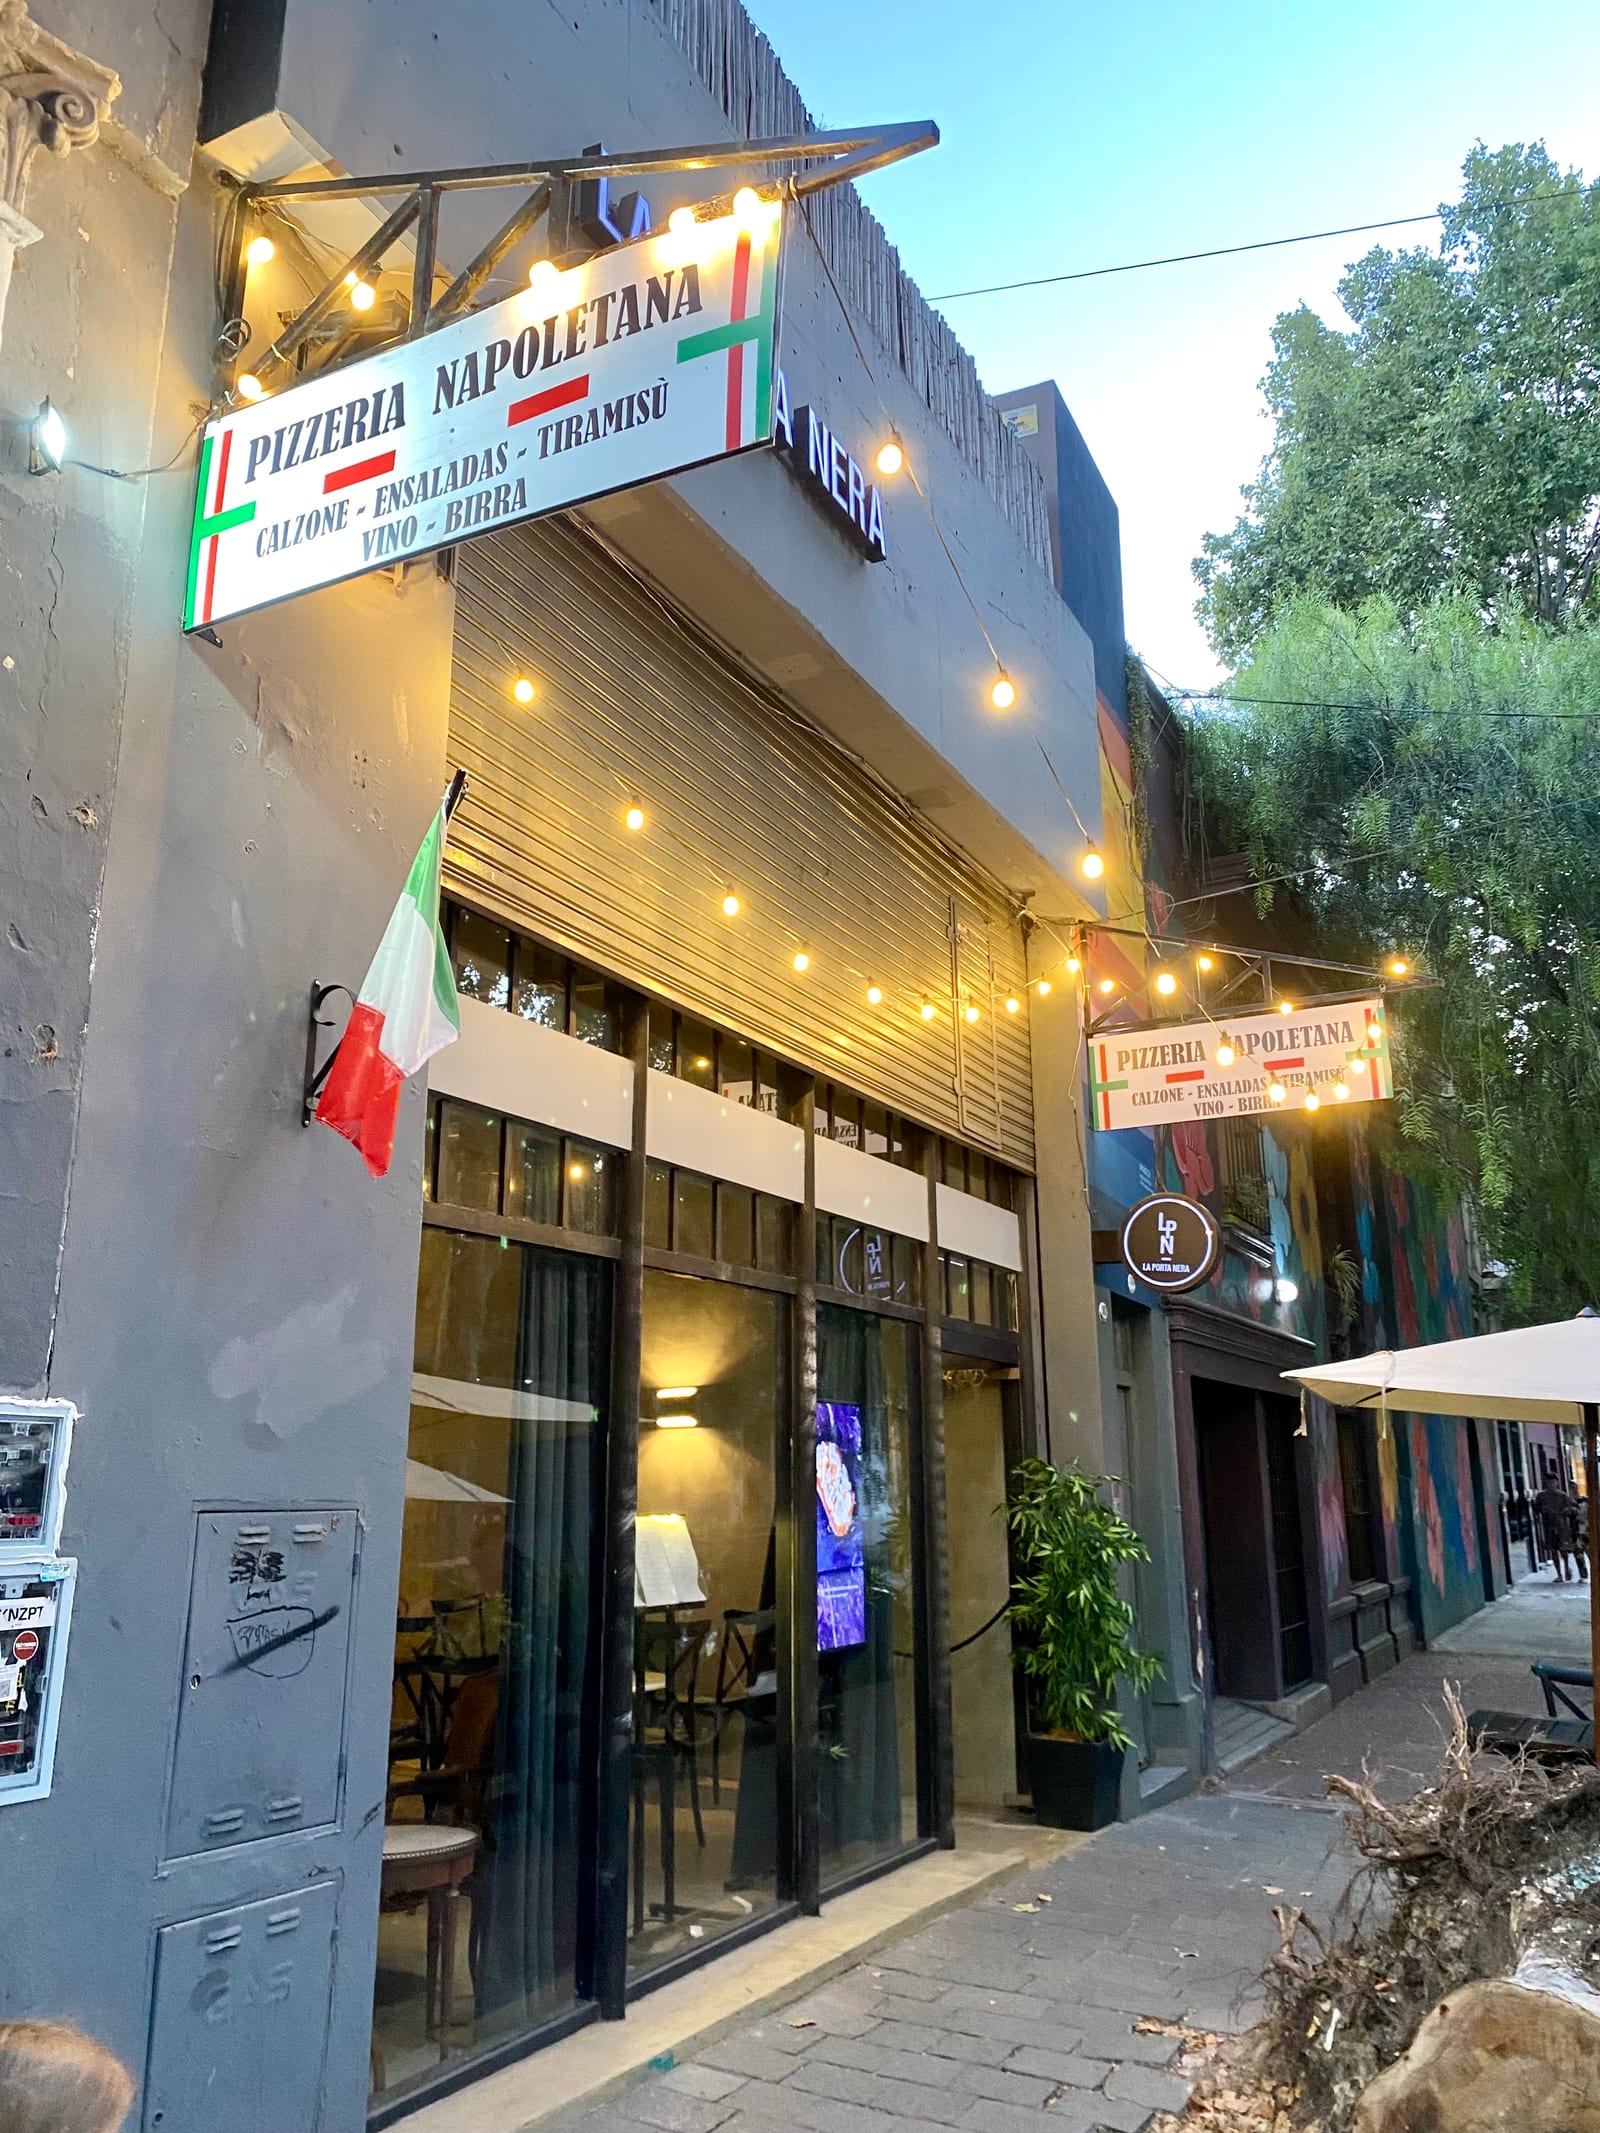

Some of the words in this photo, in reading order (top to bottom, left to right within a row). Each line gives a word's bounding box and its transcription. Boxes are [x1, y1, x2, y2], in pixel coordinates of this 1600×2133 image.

[244, 382, 405, 484] PIZZERIA
[432, 264, 702, 415] NAPOLETANA
[256, 500, 350, 558] CALZONE
[372, 441, 508, 519] ENSALADAS
[537, 377, 669, 460] TIRAMISÙ
[808, 406, 887, 557] NERA
[361, 516, 417, 561] VINO
[443, 477, 527, 535] BIRRA
[1117, 1040, 1206, 1072] PIZZERIA
[1220, 1021, 1355, 1057] APOLETANA
[1132, 1087, 1184, 1107] CALZONE
[1197, 1078, 1267, 1099] ENSALADAS
[1194, 1101, 1224, 1117] VINO
[1142, 1263, 1151, 1271] LA
[1151, 1263, 1171, 1273] PORTA
[1173, 1264, 1190, 1273] NERA
